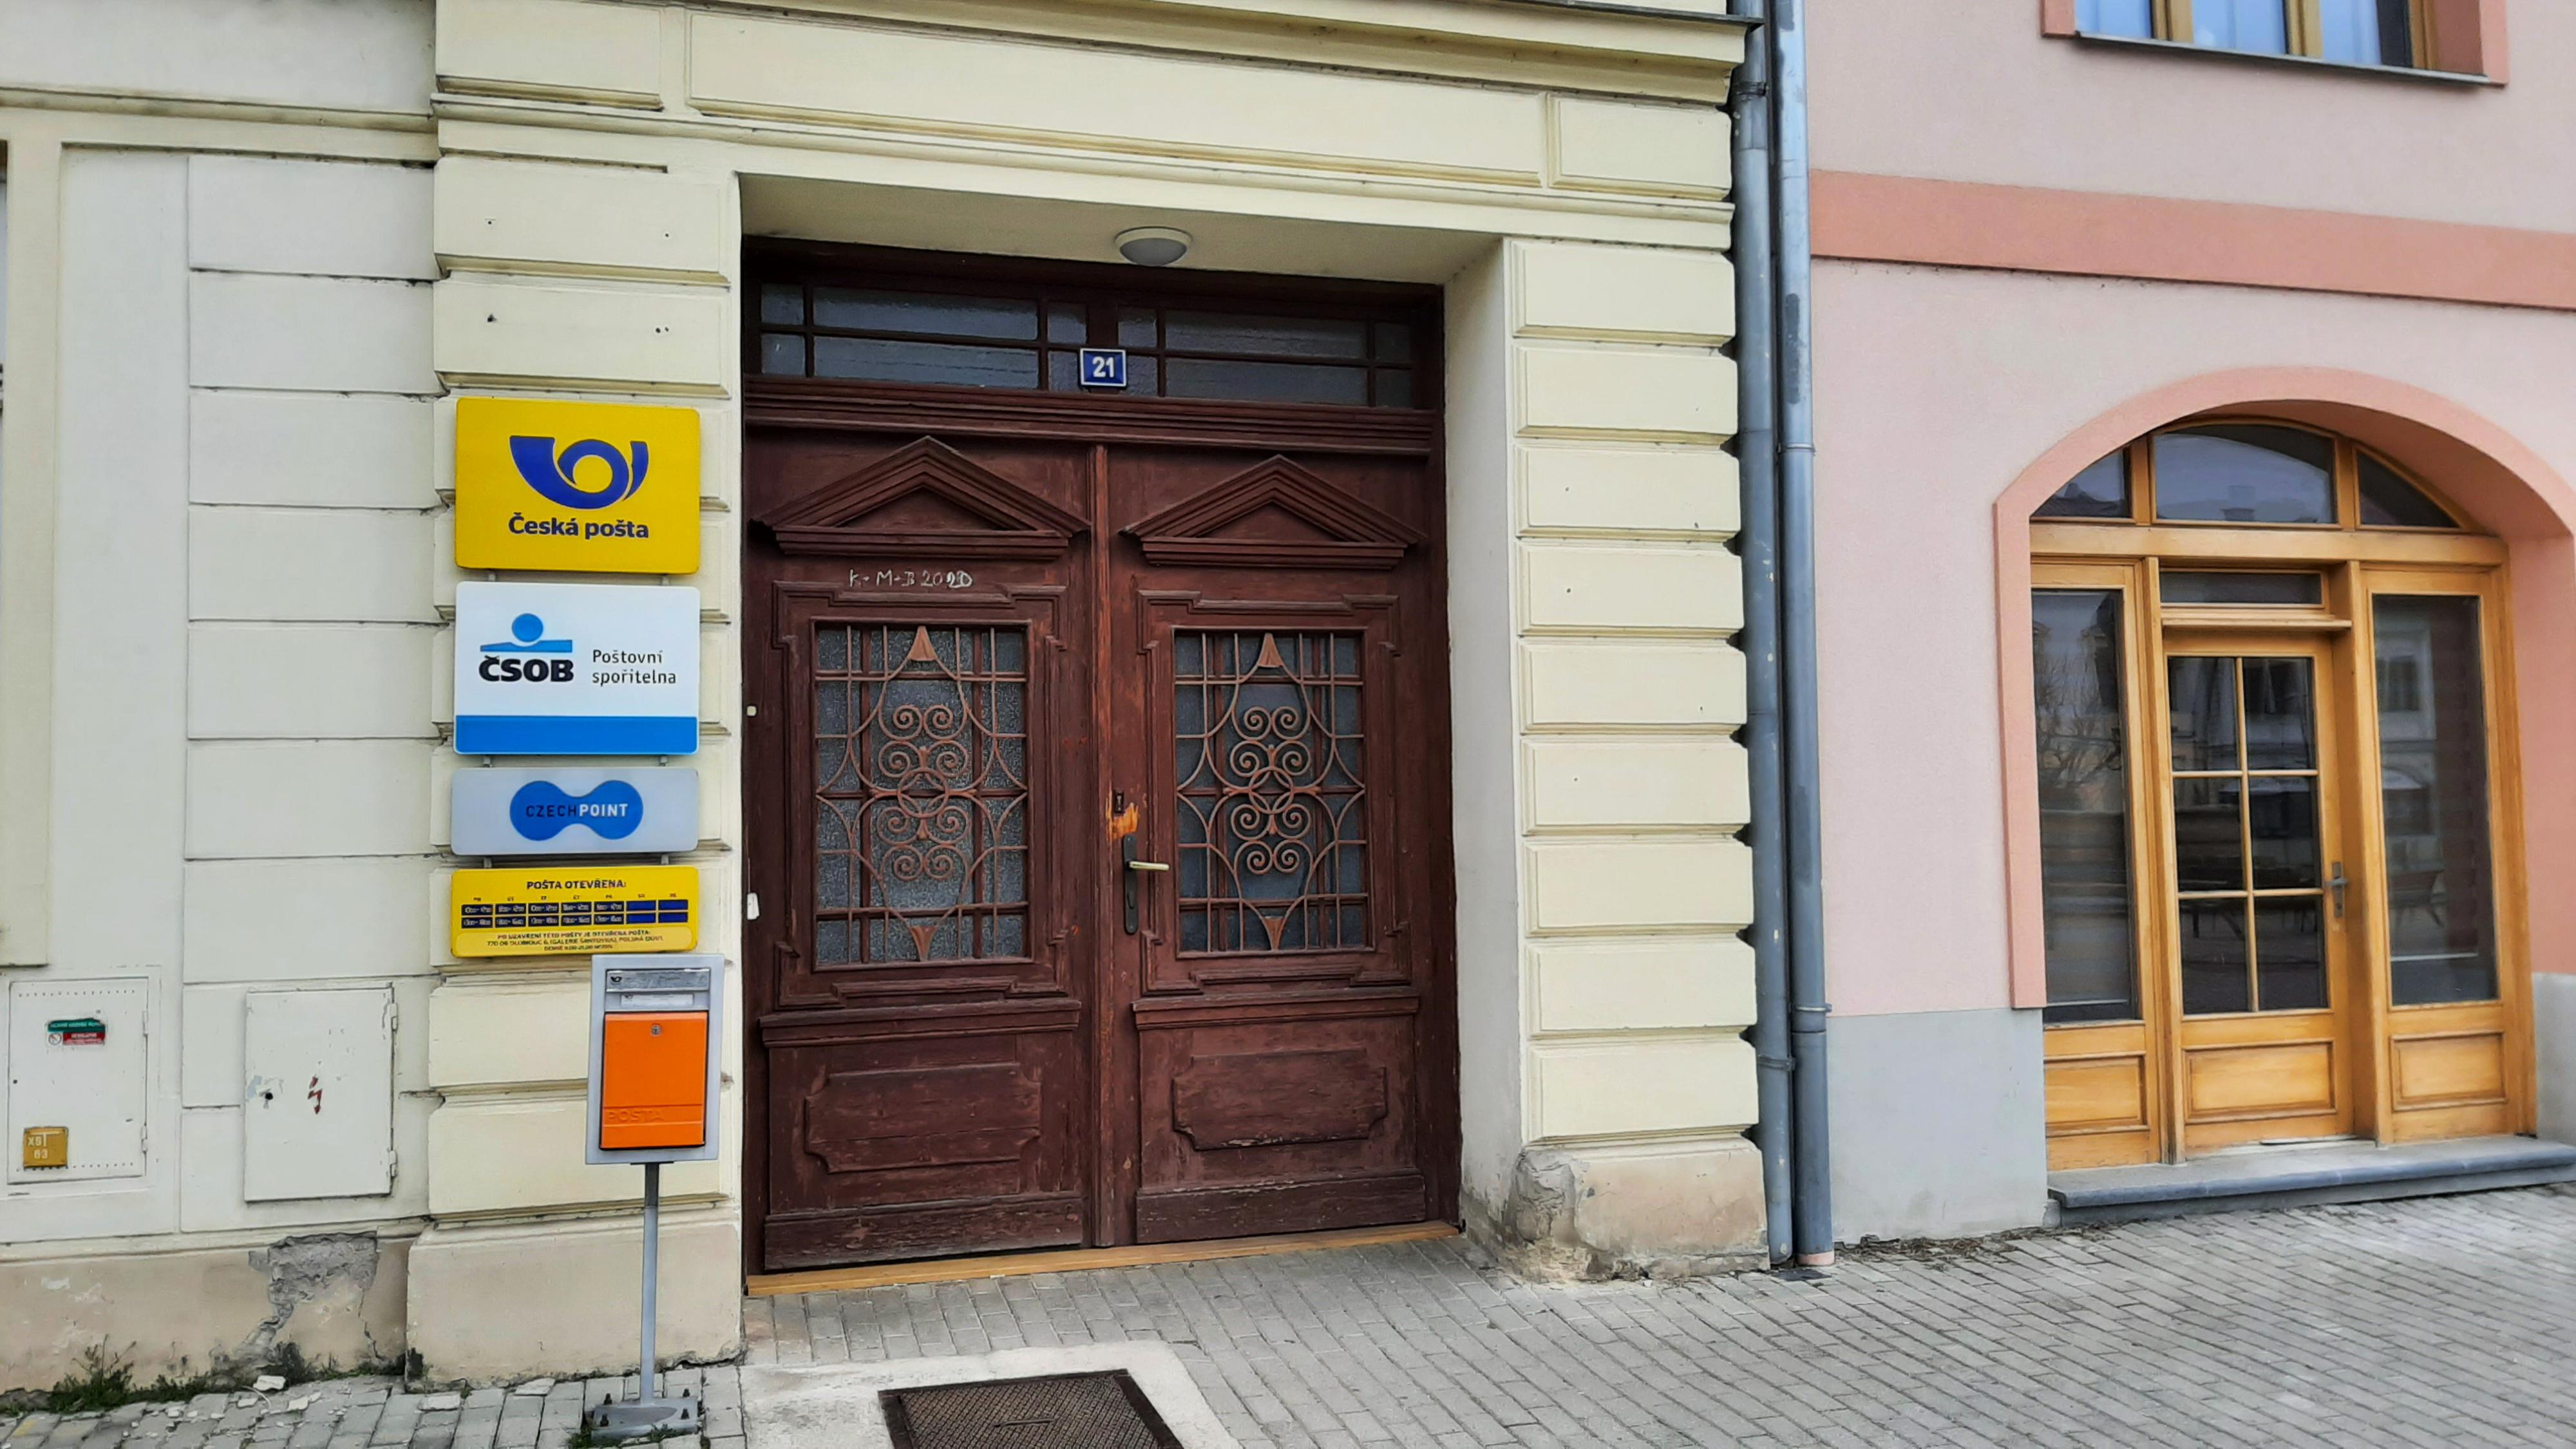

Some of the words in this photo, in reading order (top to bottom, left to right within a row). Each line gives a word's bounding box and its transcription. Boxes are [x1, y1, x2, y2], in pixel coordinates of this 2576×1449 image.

[1092, 355, 1114, 378] 21
[508, 513, 579, 536] Česká
[585, 519, 649, 540] pošta
[592, 649, 663, 664] Poštovní
[478, 655, 574, 683] ČSOB
[592, 668, 677, 687] spořitelna
[526, 880, 562, 890] POŠTA
